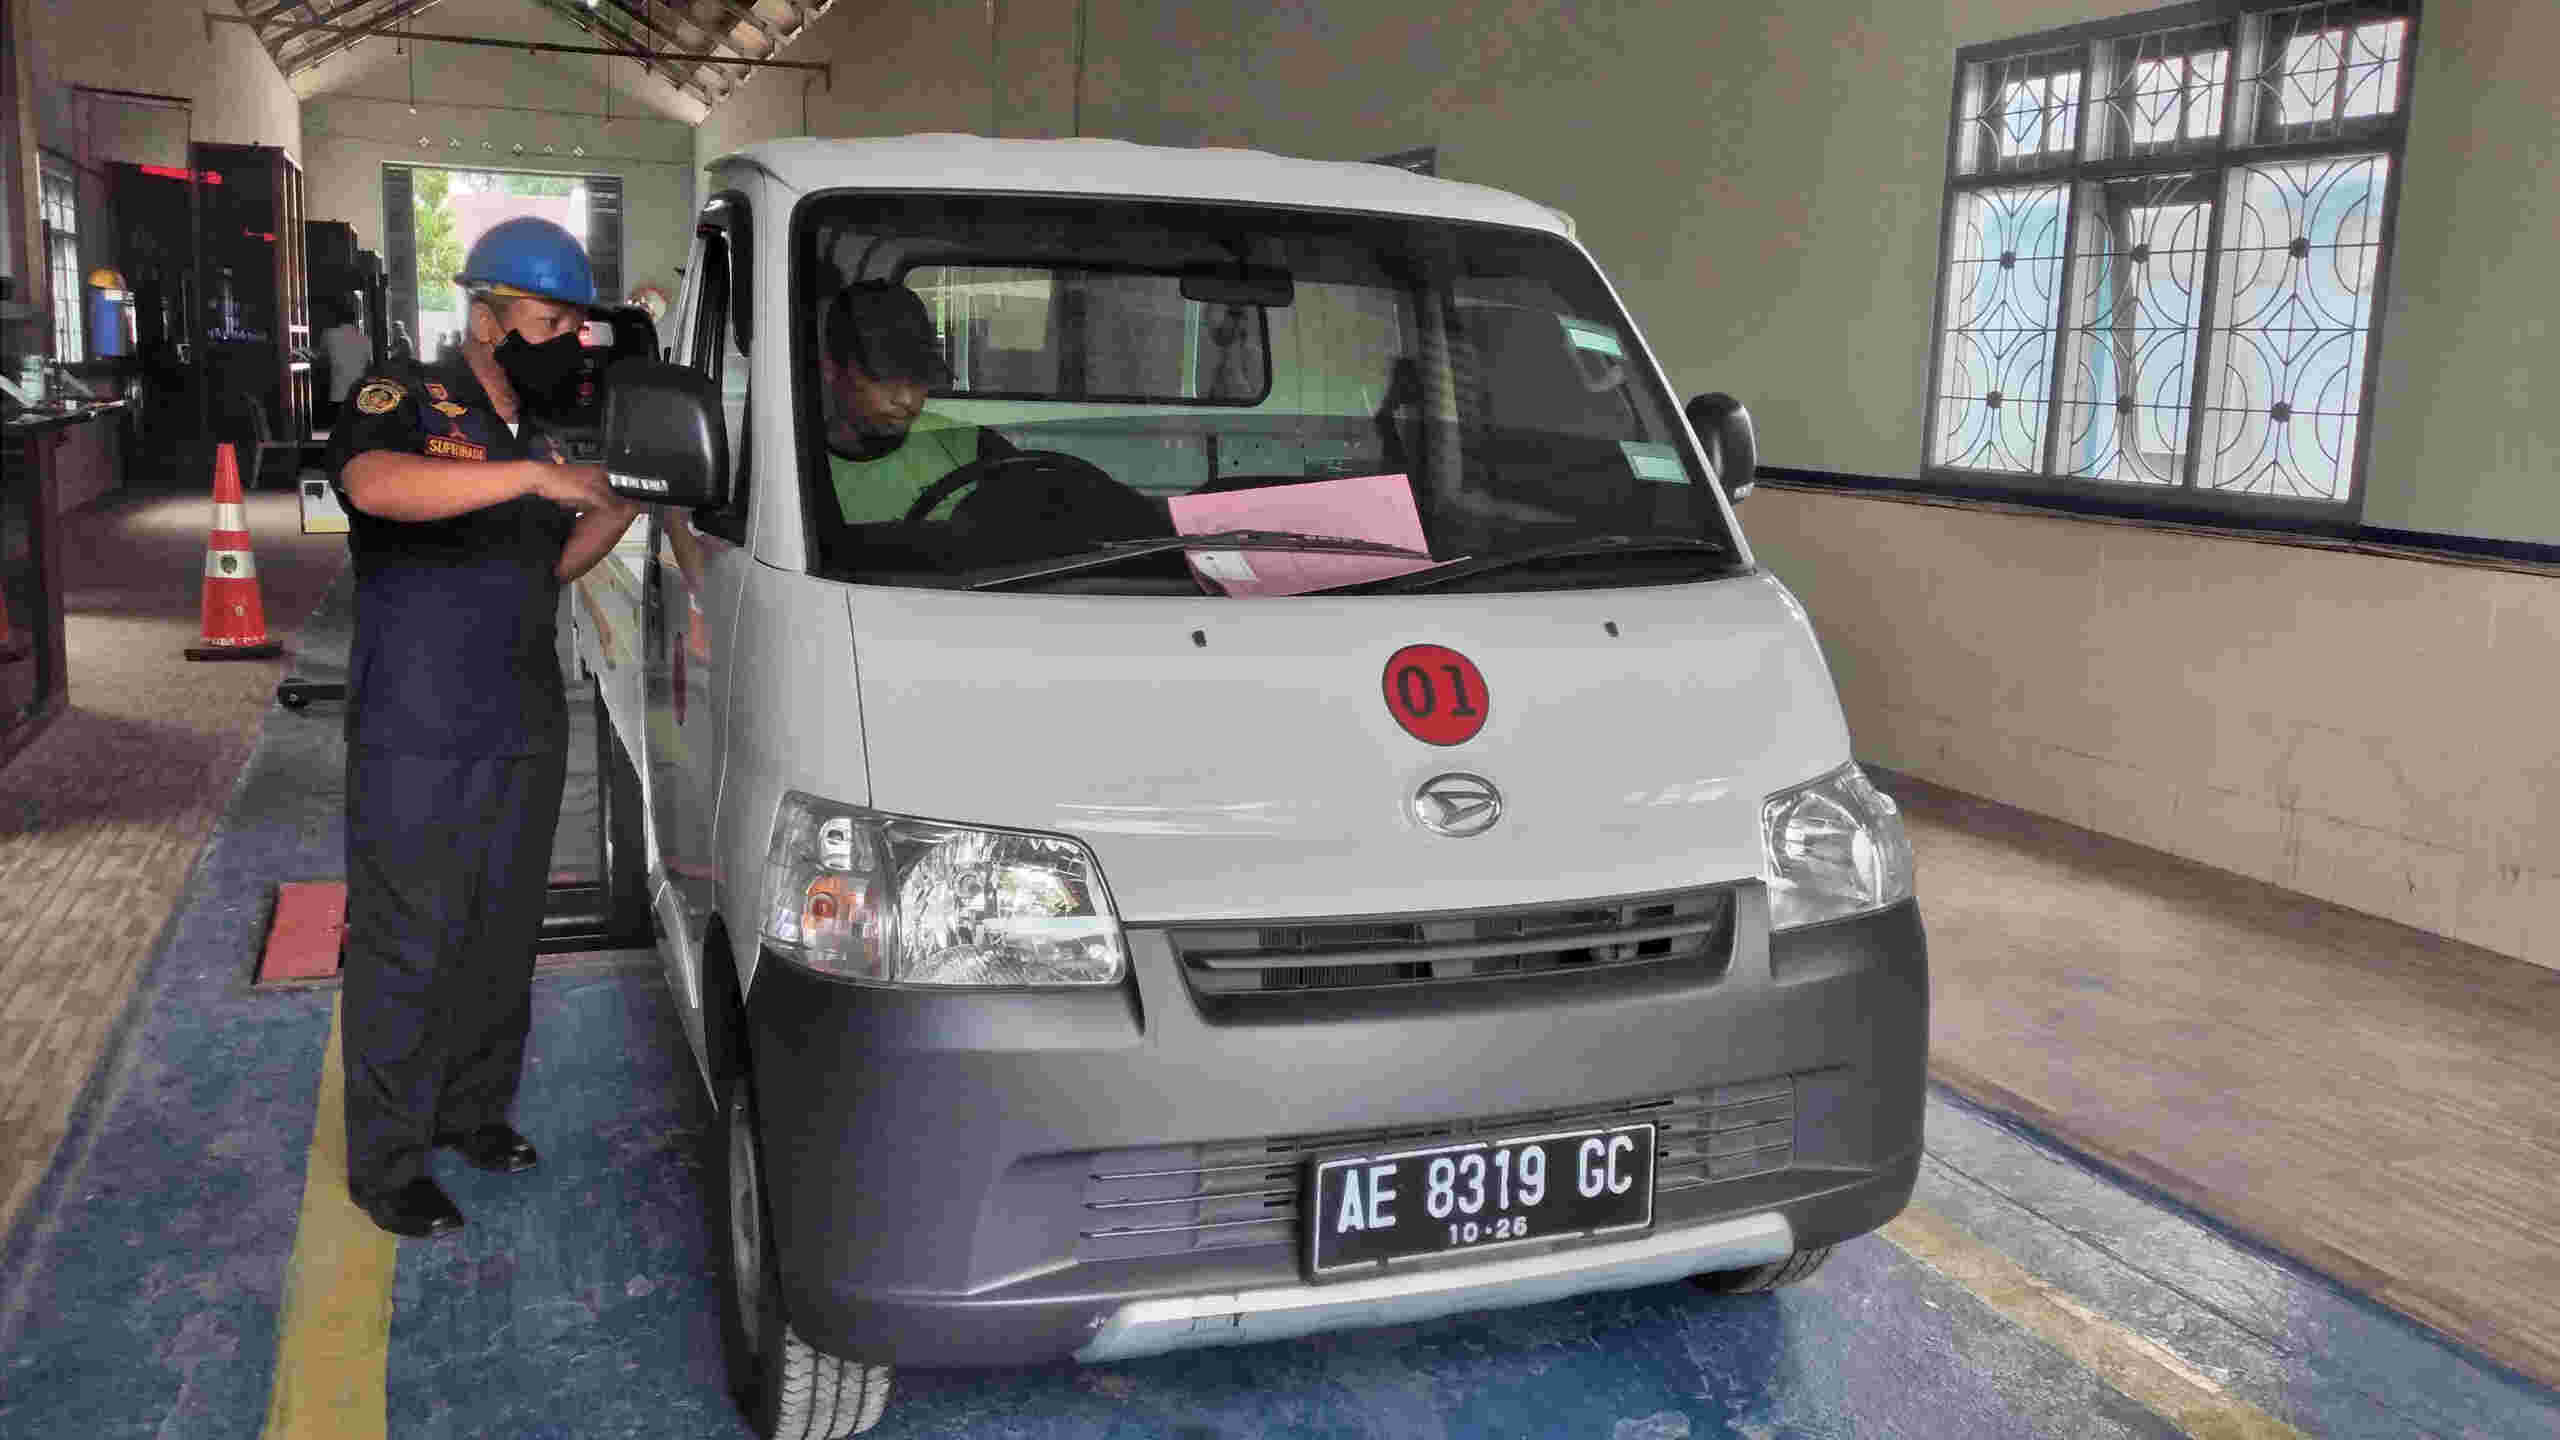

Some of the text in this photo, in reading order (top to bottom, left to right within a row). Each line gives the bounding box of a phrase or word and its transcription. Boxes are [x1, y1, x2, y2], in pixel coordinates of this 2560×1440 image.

[1397, 665, 1477, 717] 01
[1337, 1136, 1633, 1233] AE 8319 GC
